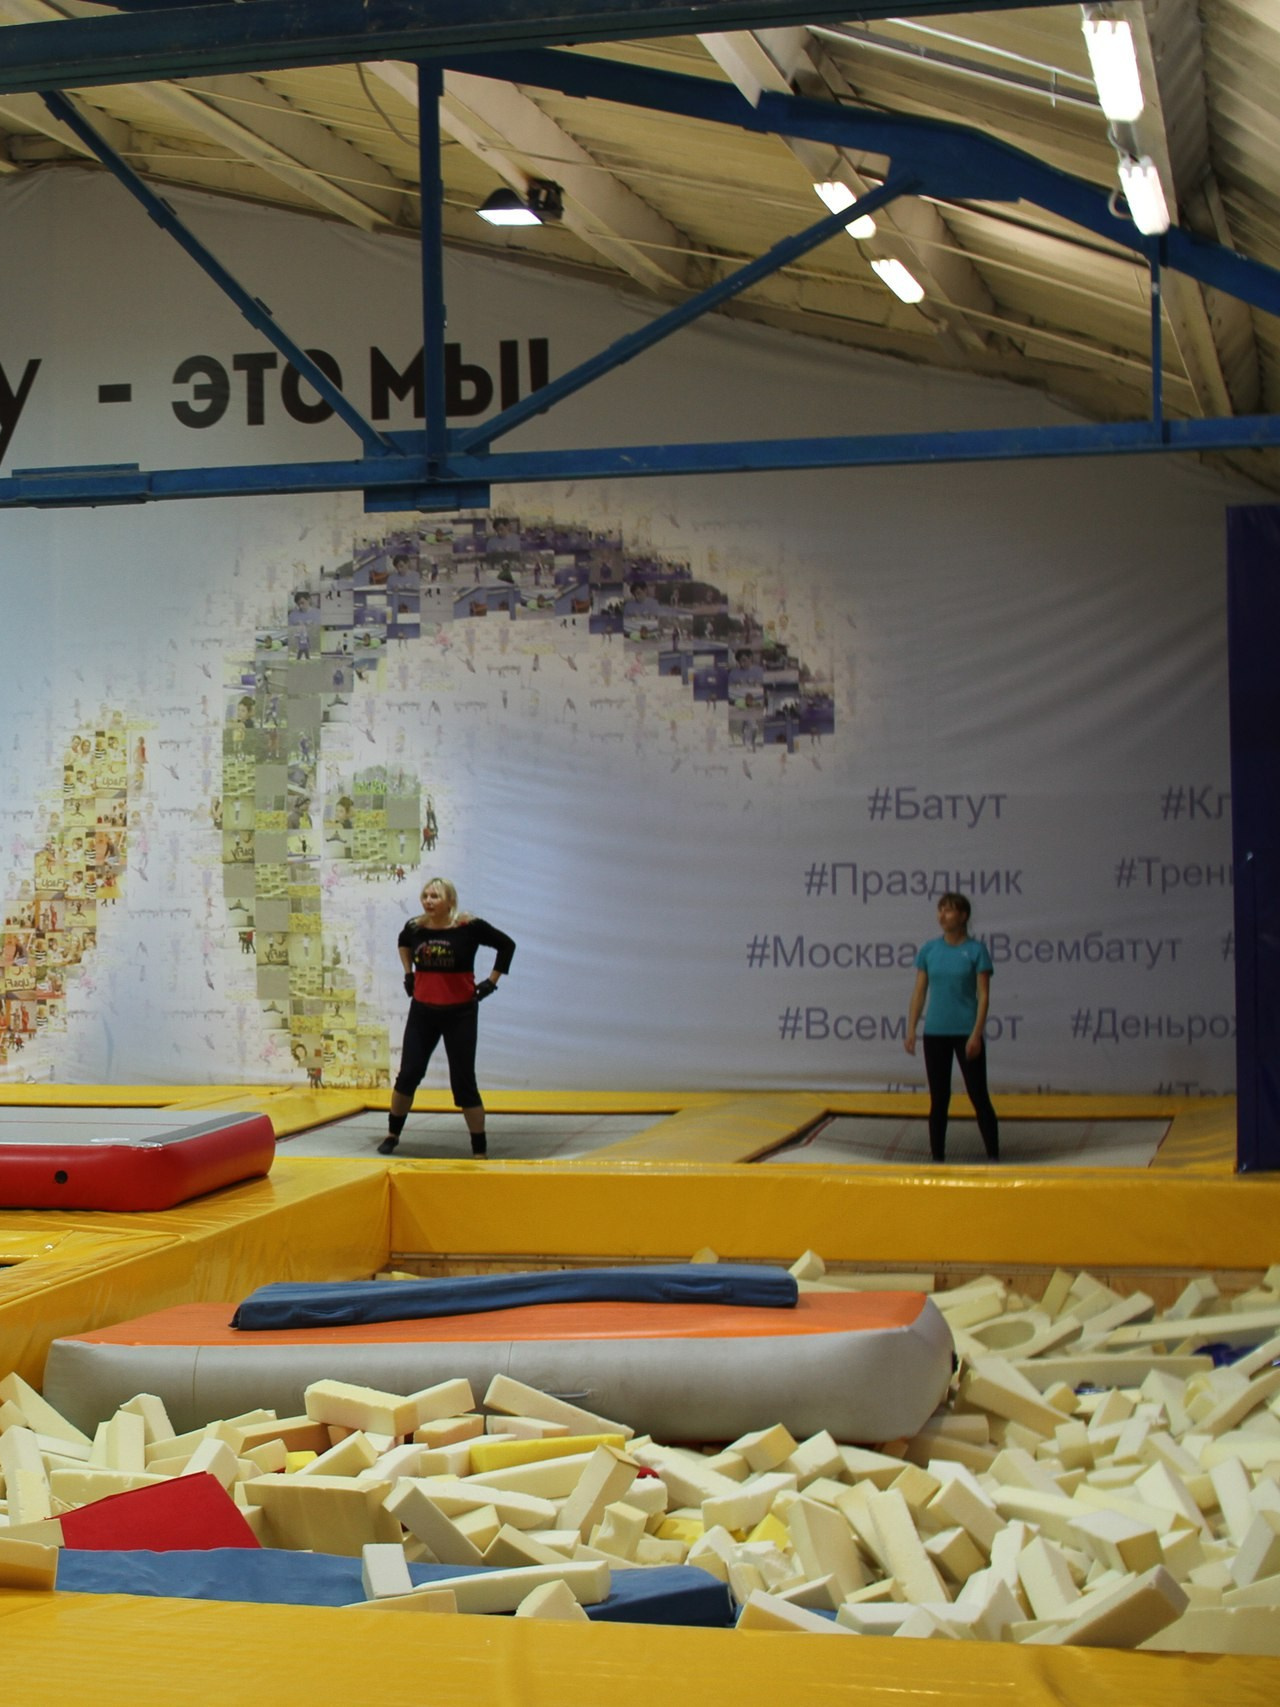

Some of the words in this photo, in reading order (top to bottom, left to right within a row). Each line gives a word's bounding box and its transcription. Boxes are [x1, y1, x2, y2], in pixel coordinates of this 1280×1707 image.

[868, 786, 1007, 829] #Батут
[805, 862, 1023, 904] #Праздник
[746, 935, 918, 968] #Москва
[1071, 1008, 1236, 1045] #Деньро
